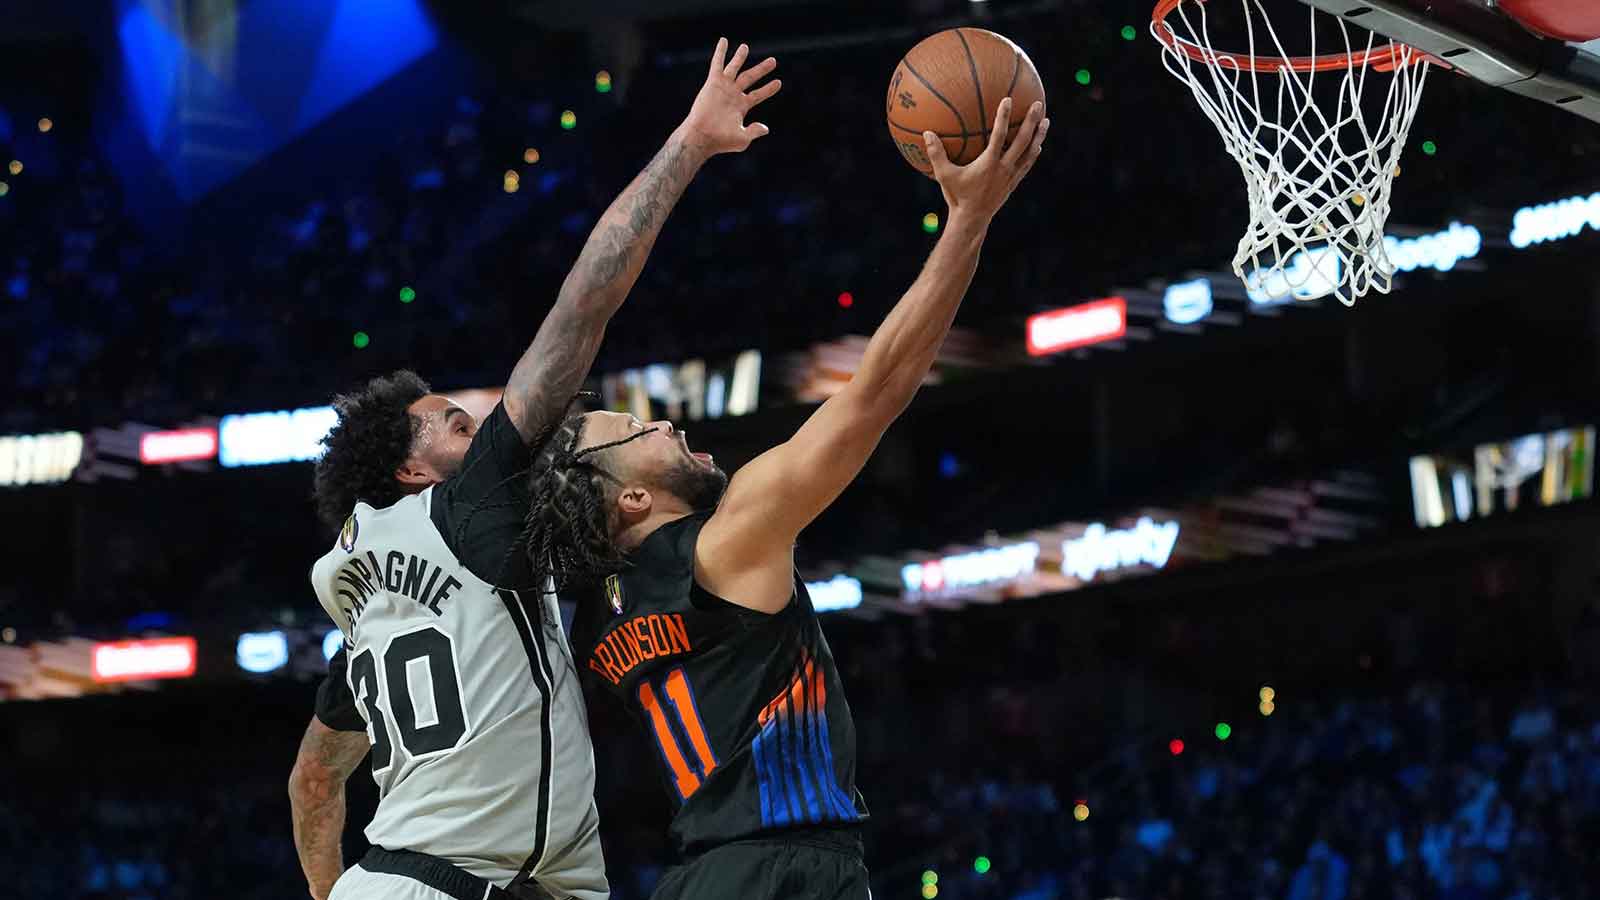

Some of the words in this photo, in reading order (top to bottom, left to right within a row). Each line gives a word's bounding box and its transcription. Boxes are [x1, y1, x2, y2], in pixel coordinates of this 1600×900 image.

[338, 550, 463, 651] AMPAGNIE
[349, 624, 471, 774] 30
[637, 666, 720, 803] 11
